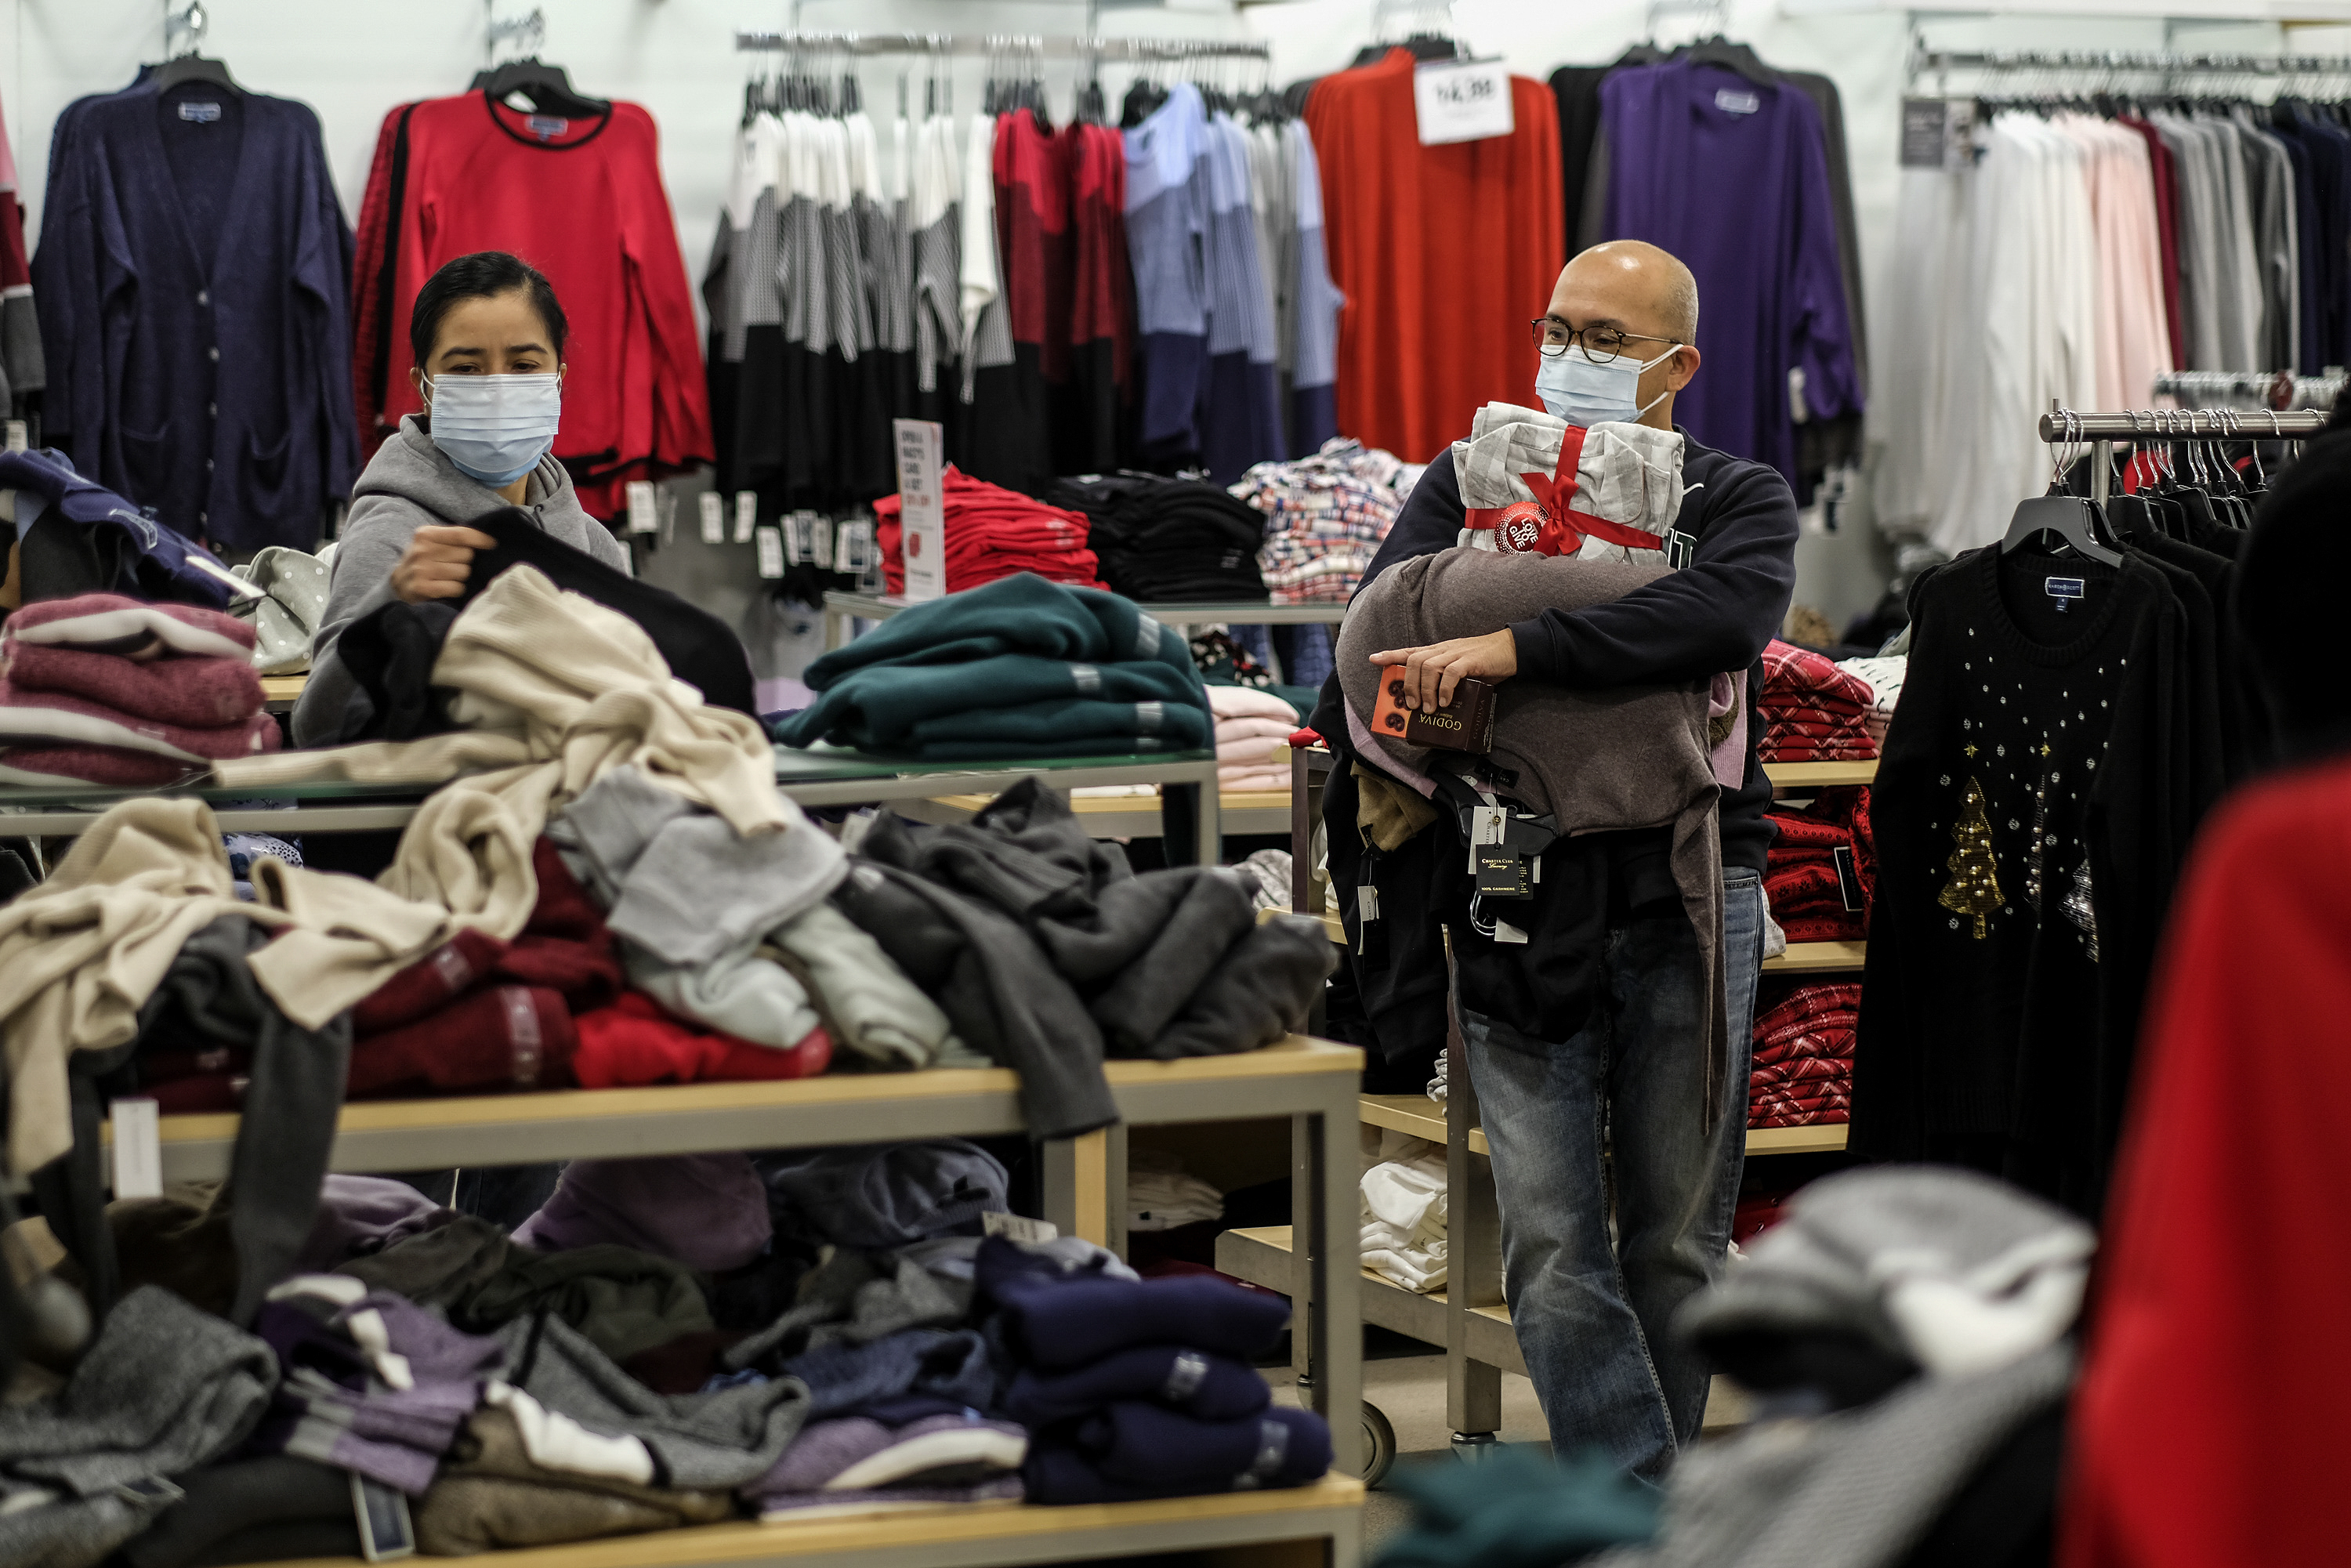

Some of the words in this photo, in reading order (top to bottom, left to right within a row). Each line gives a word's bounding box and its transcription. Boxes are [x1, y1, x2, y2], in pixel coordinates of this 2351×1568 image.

[1509, 526, 1526, 549] GIVE
[1521, 517, 1539, 544] LOVE
[1419, 714, 1462, 731] GODIVA
